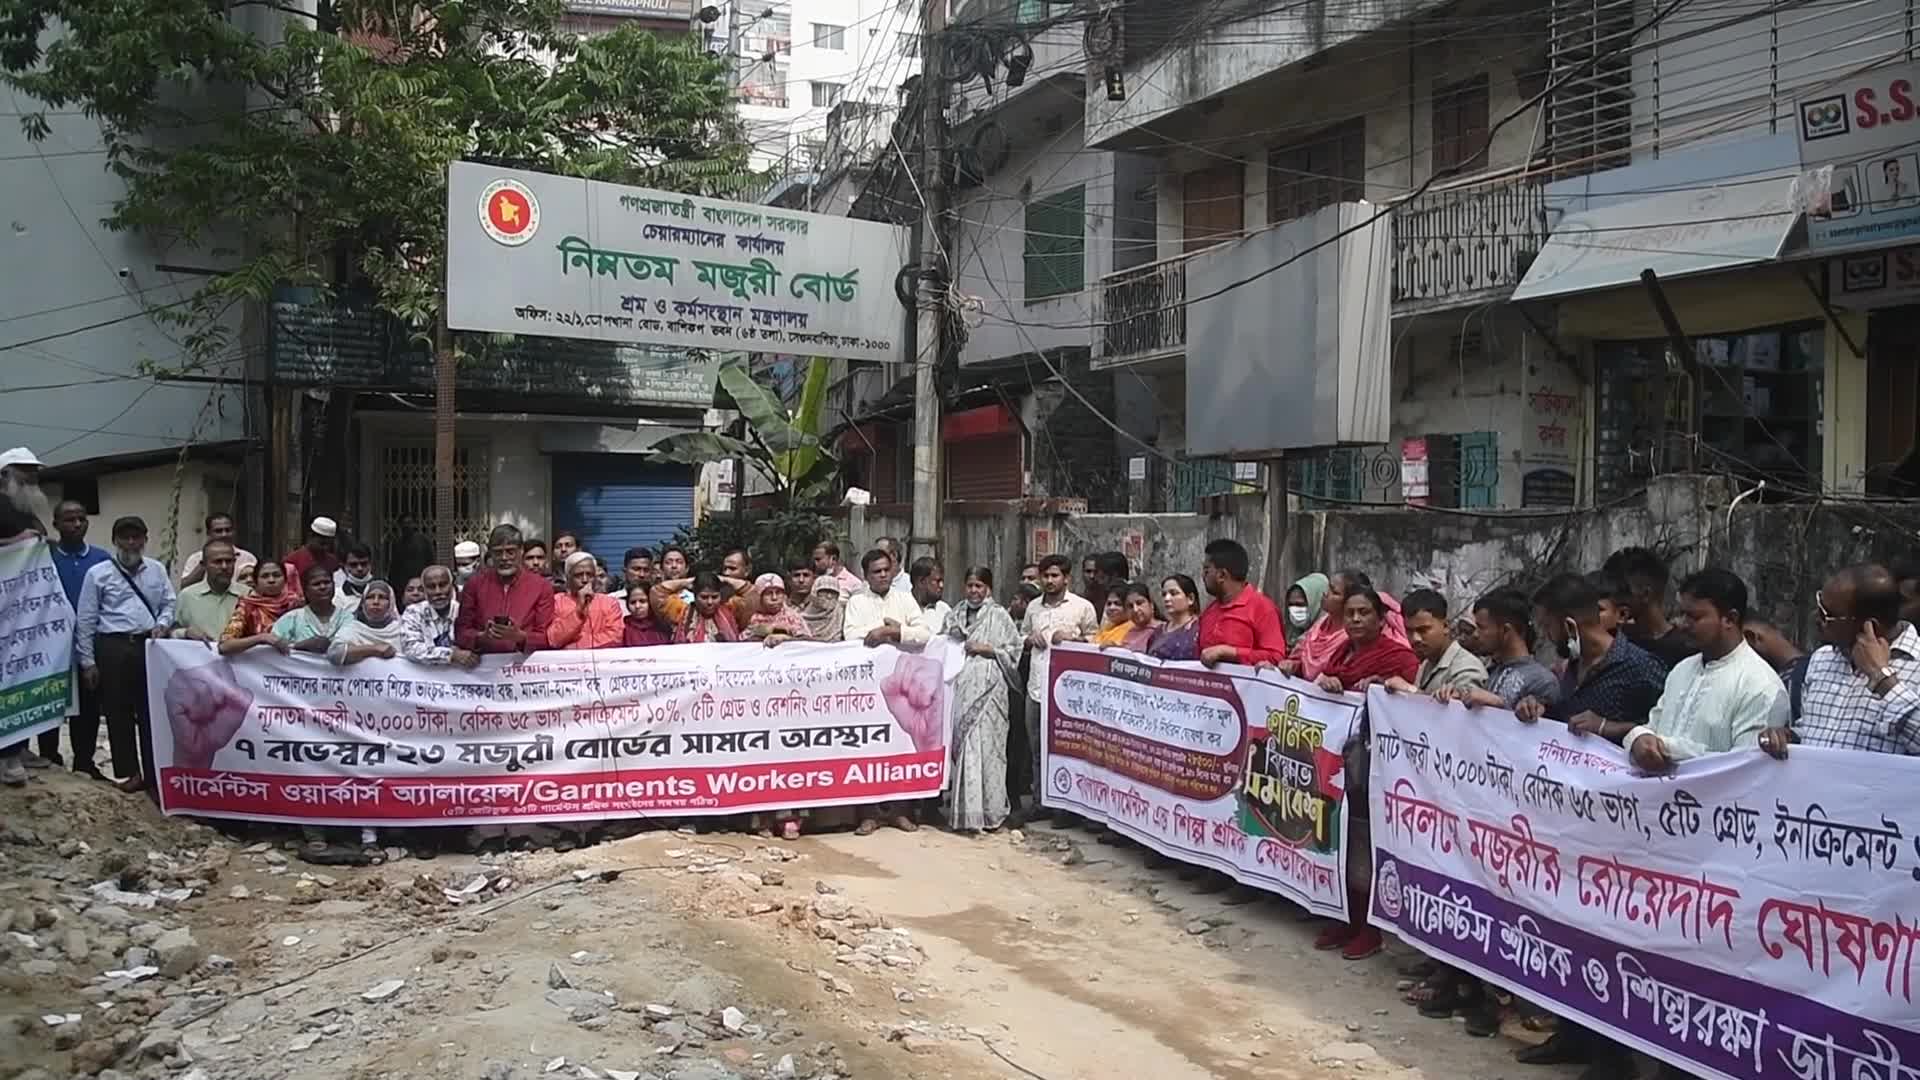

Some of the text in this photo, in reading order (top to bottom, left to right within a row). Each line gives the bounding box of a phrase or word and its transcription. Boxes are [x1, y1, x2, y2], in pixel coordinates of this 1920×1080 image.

[620, 195, 808, 235] গণপ্রজাতন্ত্রী বাংলাদেশ সরকার
[642, 222, 785, 256] চেয়ারম্যানের কার্যালয়
[557, 236, 859, 304] নিম্নতম মজুরী বোর্ড
[514, 305, 552, 322] অফিস:
[621, 295, 808, 330] শ্রম ও কর্মসংস্থান মন্ত্রণালয়
[263, 675, 318, 695] আন্দোলনের
[322, 678, 344, 696] নামে
[348, 678, 385, 697] পোশাক
[311, 701, 349, 735] মজুরী
[459, 705, 503, 733] বেসিক
[508, 712, 529, 730] ৬৫
[535, 710, 566, 730] ভাগ,
[572, 699, 640, 730] ইনক্রিমেন্ট
[647, 698, 685, 726] ১০%,
[692, 693, 714, 721] ৫টি
[720, 699, 746, 720] গ্রেড
[751, 699, 761, 717] ও
[766, 689, 808, 718] রেশনিং
[812, 695, 832, 717] এর
[836, 686, 876, 714] দাবিতে
[1266, 695, 1327, 752] শ্রমিক
[235, 739, 255, 761] ৭
[456, 734, 554, 772] মজুরী
[565, 730, 671, 762] বোর্ডের
[681, 730, 770, 755] সামনে
[778, 724, 891, 749] অবস্থান
[1538, 739, 1584, 765] দুনিয়ার
[169, 772, 270, 801] গার্মেন্টস
[280, 778, 384, 806] ওয়ার্কার্স
[705, 768, 833, 797] Workers
[844, 761, 944, 786] Allianc
[1243, 744, 1327, 841] সমাবেশ
[1111, 785, 1150, 825] গার্মেন্টস
[1173, 804, 1207, 844] শিল্প
[1212, 817, 1248, 856] শ্রমিক
[1256, 838, 1334, 895] ফেডারেশন
[1523, 764, 1564, 814] বেসিক
[1569, 782, 1596, 822] ৬৫
[1599, 788, 1651, 842] ভাগ,
[1659, 789, 1702, 837] ৫টি
[1713, 801, 1762, 859] গ্রেড,
[1774, 798, 1902, 871] ইনক্রিমেন্ট
[1467, 814, 1561, 898] মজুরীর
[1577, 854, 1741, 952] রোয়েদাদ
[1757, 898, 1920, 1004] ঘোষণা
[1402, 883, 1494, 954] গার্মেন্টস
[1498, 914, 1573, 987] শ্রমিক
[1581, 958, 1610, 1004] ও
[1615, 951, 1770, 1074] শিল্পরক্ষা
